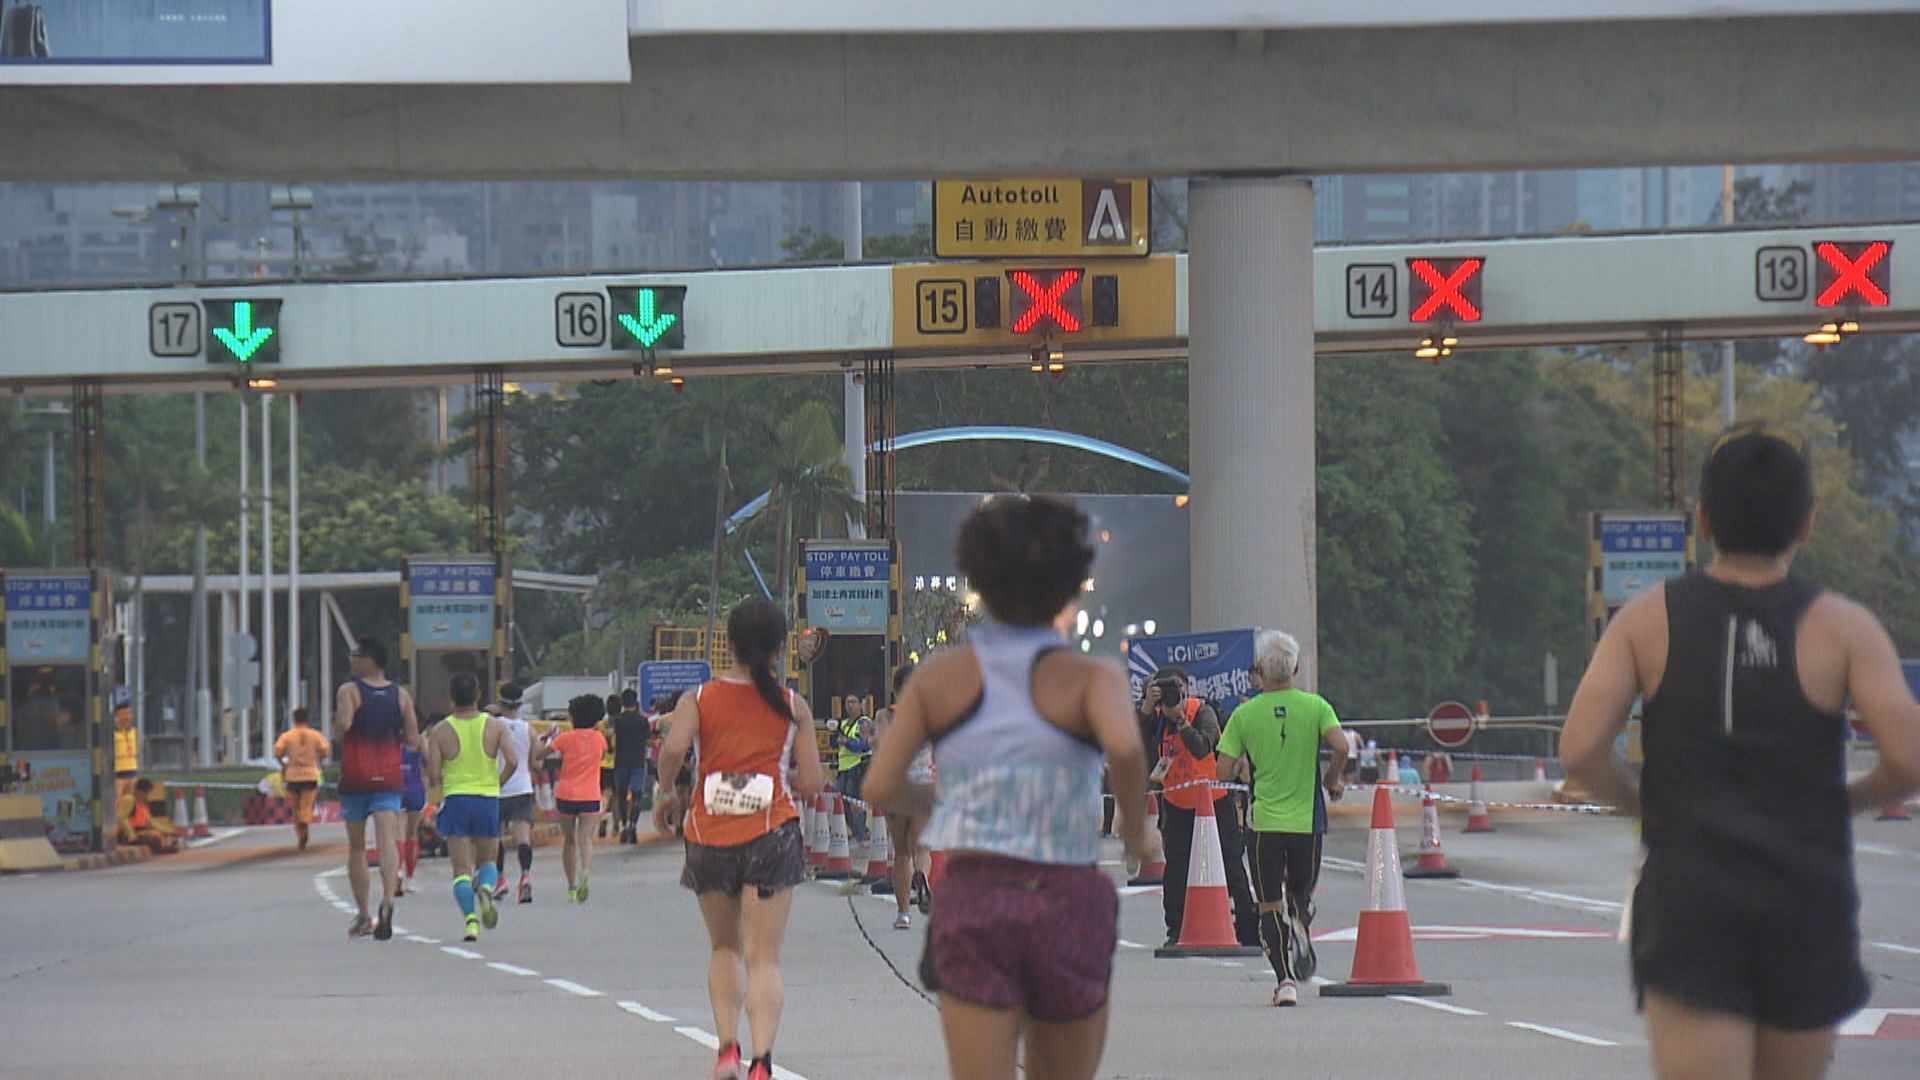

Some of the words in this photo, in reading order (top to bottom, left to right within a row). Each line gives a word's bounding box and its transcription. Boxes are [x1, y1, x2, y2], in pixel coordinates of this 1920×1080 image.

[962, 185, 1060, 205] Autotoll
[956, 217, 1067, 242] 自動繳費
[1355, 273, 1389, 309] 14
[1764, 256, 1799, 292] 13
[563, 302, 597, 337] 16
[925, 288, 958, 324] 15
[158, 312, 190, 348] 17
[840, 551, 861, 561] PAY
[863, 551, 889, 561] TOLL
